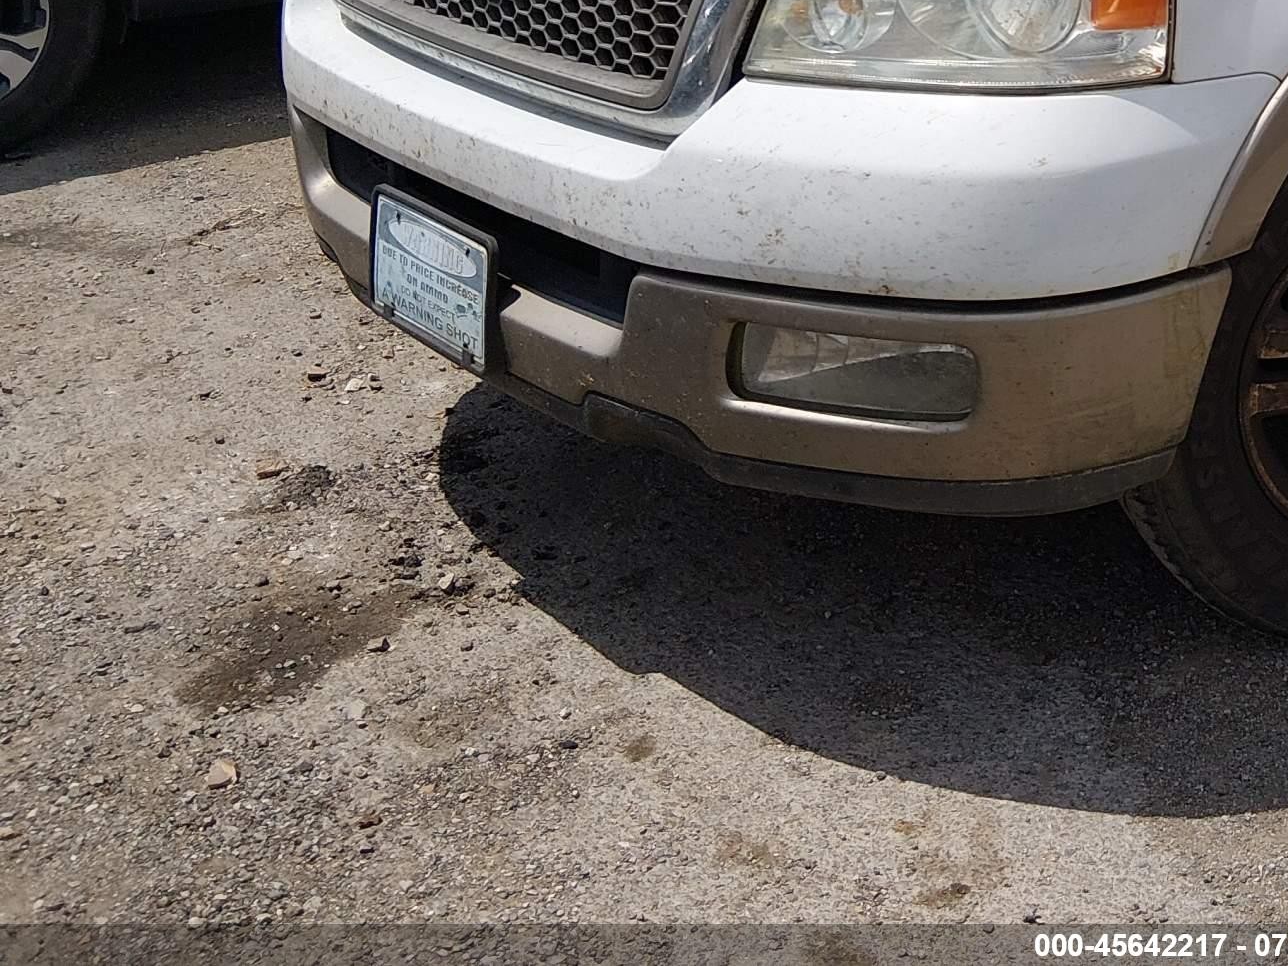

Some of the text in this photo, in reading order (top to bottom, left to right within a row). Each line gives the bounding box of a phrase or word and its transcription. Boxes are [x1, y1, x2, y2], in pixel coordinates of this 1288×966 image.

[382, 245, 480, 305] DUE TO PRICE INCREASE
[407, 273, 418, 287] ON
[382, 287, 479, 350] A WARNING SHOT
[401, 285, 456, 325] DO NOT EXPECT
